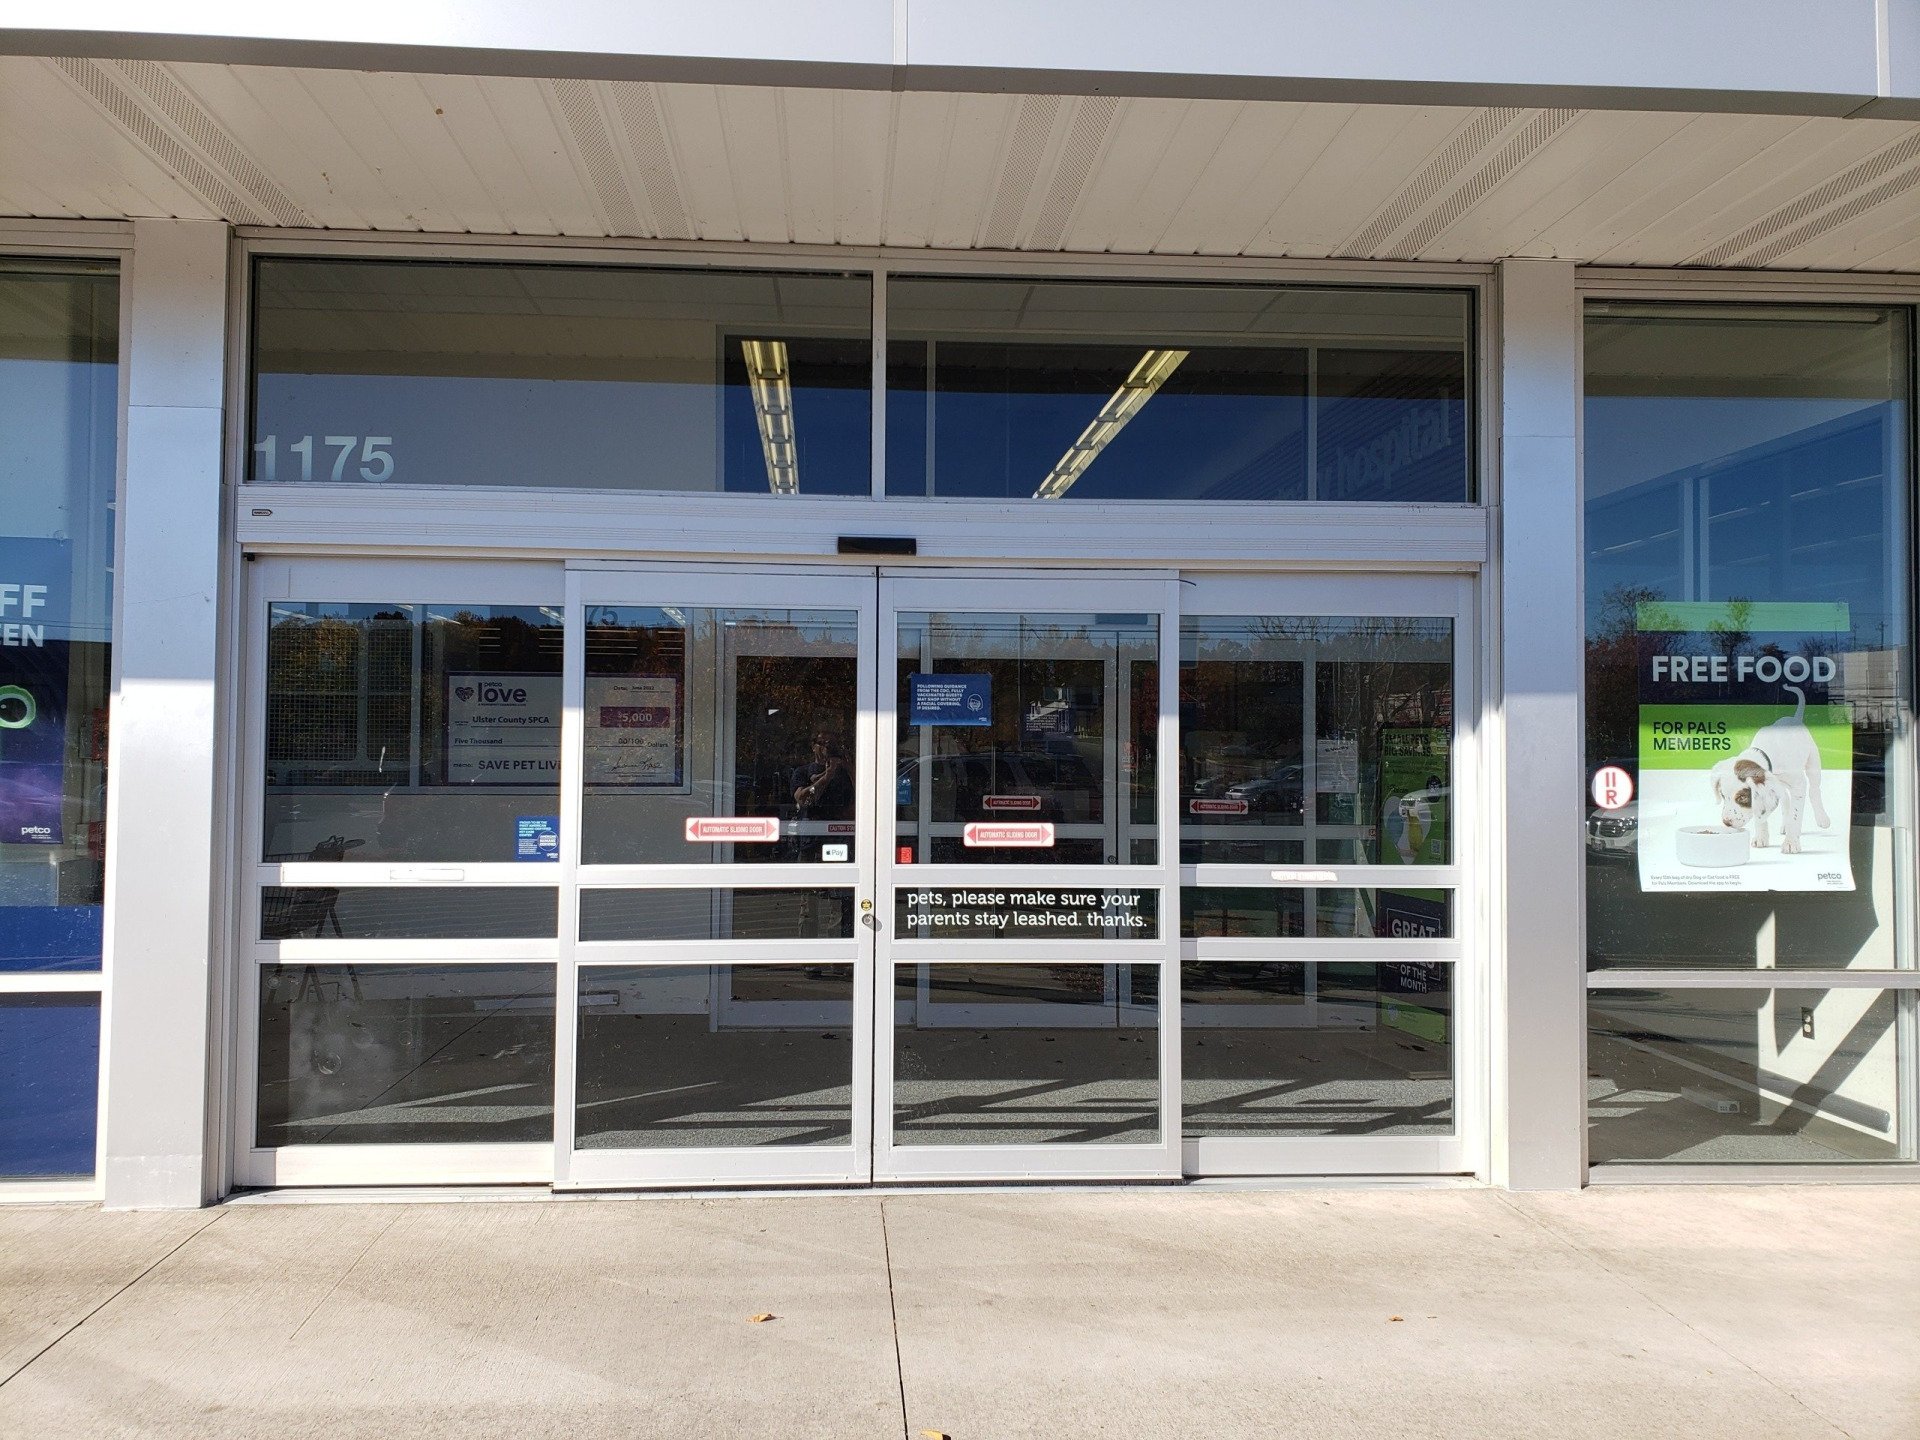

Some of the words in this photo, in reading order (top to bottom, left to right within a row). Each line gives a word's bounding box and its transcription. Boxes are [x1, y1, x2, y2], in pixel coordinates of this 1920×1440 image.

[254, 435, 394, 483] 1175
[0, 623, 44, 648] EN
[1652, 656, 1728, 682] FREE
[1737, 655, 1836, 683] FOOD
[478, 682, 527, 703] love
[472, 716, 496, 724] Ulster
[498, 716, 527, 725] County
[528, 716, 550, 724] SPCA
[1653, 721, 1683, 734] FOR
[1688, 722, 1727, 735] PALS
[1653, 737, 1731, 751] MEMBERS
[478, 760, 510, 770] SAVE
[513, 760, 536, 770] PET
[538, 760, 561, 770] LIV
[1606, 790, 1617, 805] R
[21, 826, 51, 836] petco
[702, 825, 729, 833] AUTOMATIC
[730, 825, 749, 833] SLIDING
[749, 825, 763, 833] DOOR
[979, 831, 1005, 839] AUTOMATIC
[1006, 831, 1024, 839] SLIDING
[1024, 831, 1038, 839] DOOR
[831, 849, 844, 858] Pay
[1817, 872, 1842, 880] petco
[907, 892, 947, 908] pets,
[952, 891, 1005, 908] please
[1010, 891, 1056, 905] make
[1060, 893, 1096, 906] sure
[1100, 893, 1140, 909] your
[907, 912, 970, 929] parents
[974, 913, 1009, 929] stay
[1013, 912, 1082, 927] leashed.
[1087, 912, 1147, 927] thanks.
[1391, 918, 1436, 938] GREAT
[1400, 965, 1411, 975] OF
[1412, 967, 1427, 981] THE
[1400, 977, 1427, 993] MONTH
